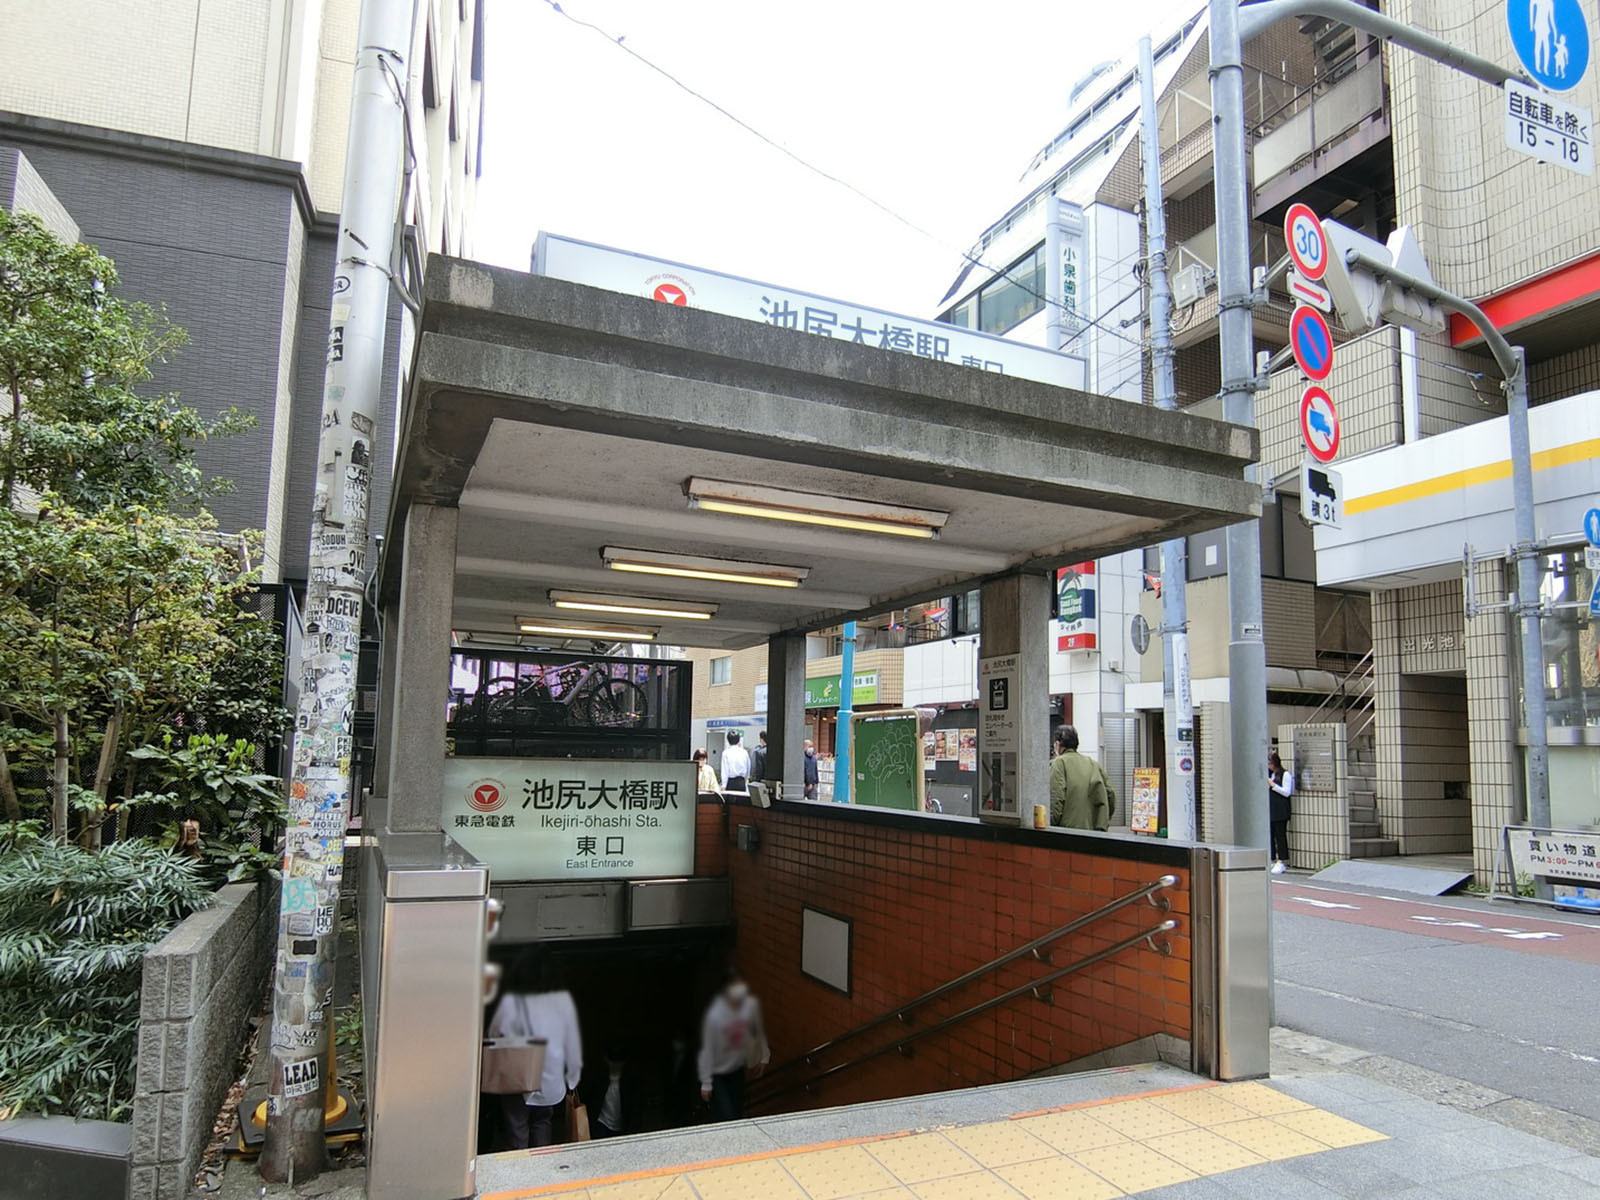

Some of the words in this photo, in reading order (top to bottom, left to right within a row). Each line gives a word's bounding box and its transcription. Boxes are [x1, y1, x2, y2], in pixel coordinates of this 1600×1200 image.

[1509, 91, 1588, 140] 自転車を除く
[1296, 224, 1319, 261] 30
[1063, 247, 1076, 311] 小泉歯科
[1311, 499, 1335, 522] 積3t
[326, 597, 359, 618] DCEVE
[1403, 635, 1465, 651] 出光池
[521, 778, 679, 811] 池尻大橋駅
[454, 814, 515, 828] 東急電鉄
[541, 814, 631, 831] Ikejiri-ōhashi
[635, 814, 662, 828] Sta.
[576, 835, 625, 856] 東口
[1529, 839, 1597, 857] 買い物道
[566, 858, 588, 868] East
[591, 858, 634, 868] Entrance
[285, 1060, 317, 1086] LEAD
